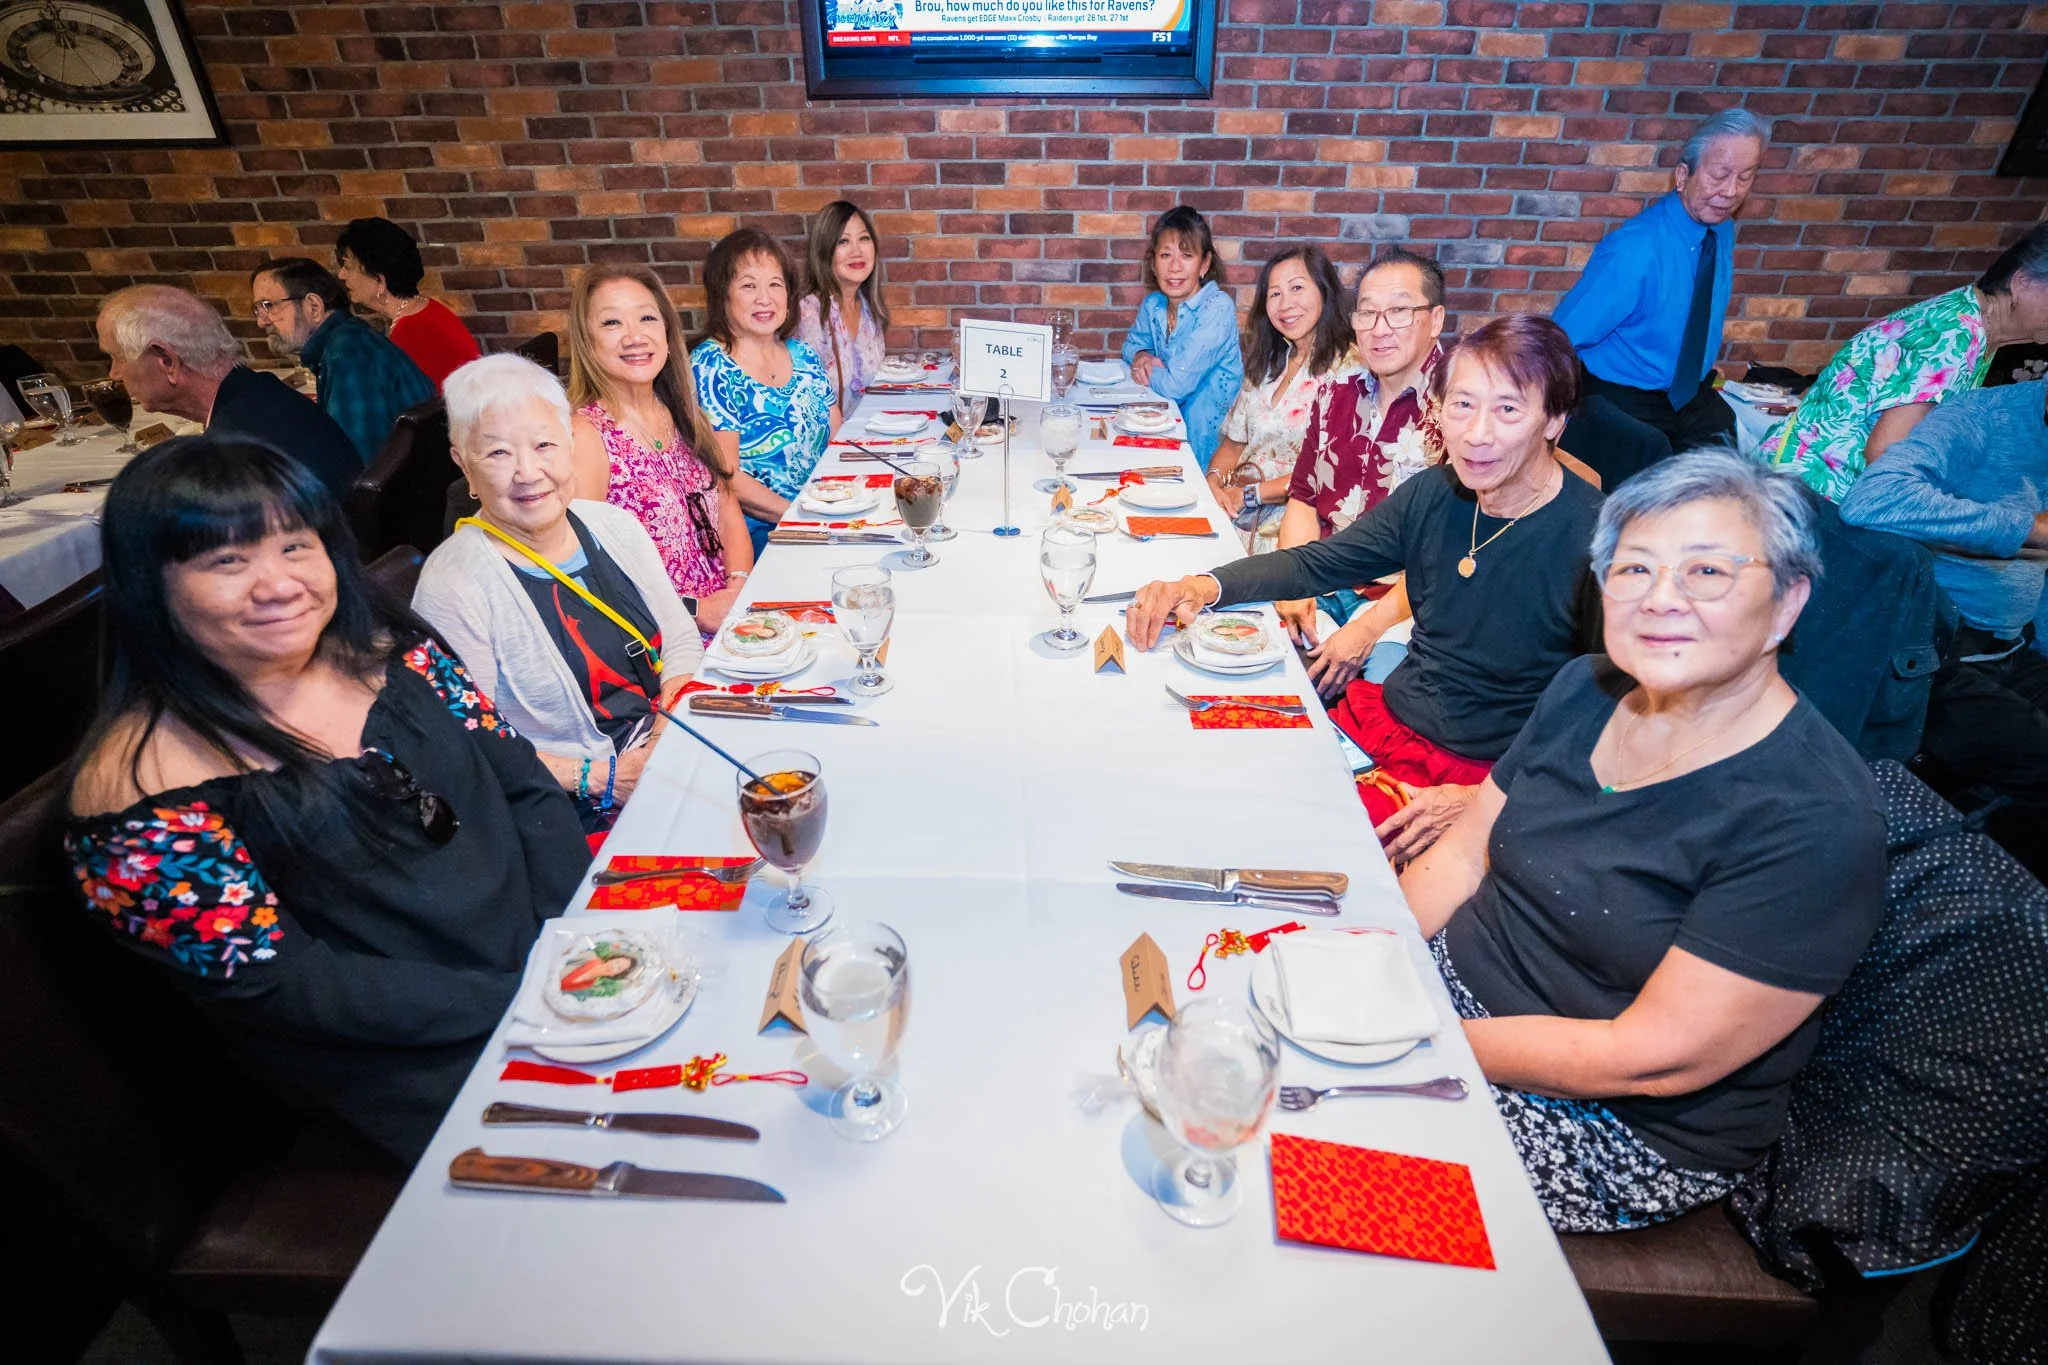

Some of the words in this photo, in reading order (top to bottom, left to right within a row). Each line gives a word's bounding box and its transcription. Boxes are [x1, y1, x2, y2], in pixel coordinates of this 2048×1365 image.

[915, 0, 944, 13] Brou,
[947, 0, 970, 11] how
[972, 0, 1004, 11] much
[1006, 0, 1020, 11] do
[1022, 0, 1043, 14] you
[1045, 0, 1065, 11] like
[1067, 0, 1087, 11] this
[1090, 0, 1105, 11] for
[1107, 0, 1155, 11] Ravens?
[857, 14, 896, 27] MAXX
[941, 14, 967, 22] Ravens
[967, 15, 978, 24] get
[979, 14, 997, 22] EDGE
[998, 14, 1017, 22] Maxx
[1017, 14, 1042, 23] Crosby
[1047, 14, 1073, 22] Raiders
[1074, 15, 1085, 23] get
[1110, 14, 1119, 22] 27
[1119, 14, 1129, 22] 1st
[1152, 32, 1172, 42] FS1
[985, 344, 1023, 357] TABLE
[1000, 368, 1007, 379] 2
